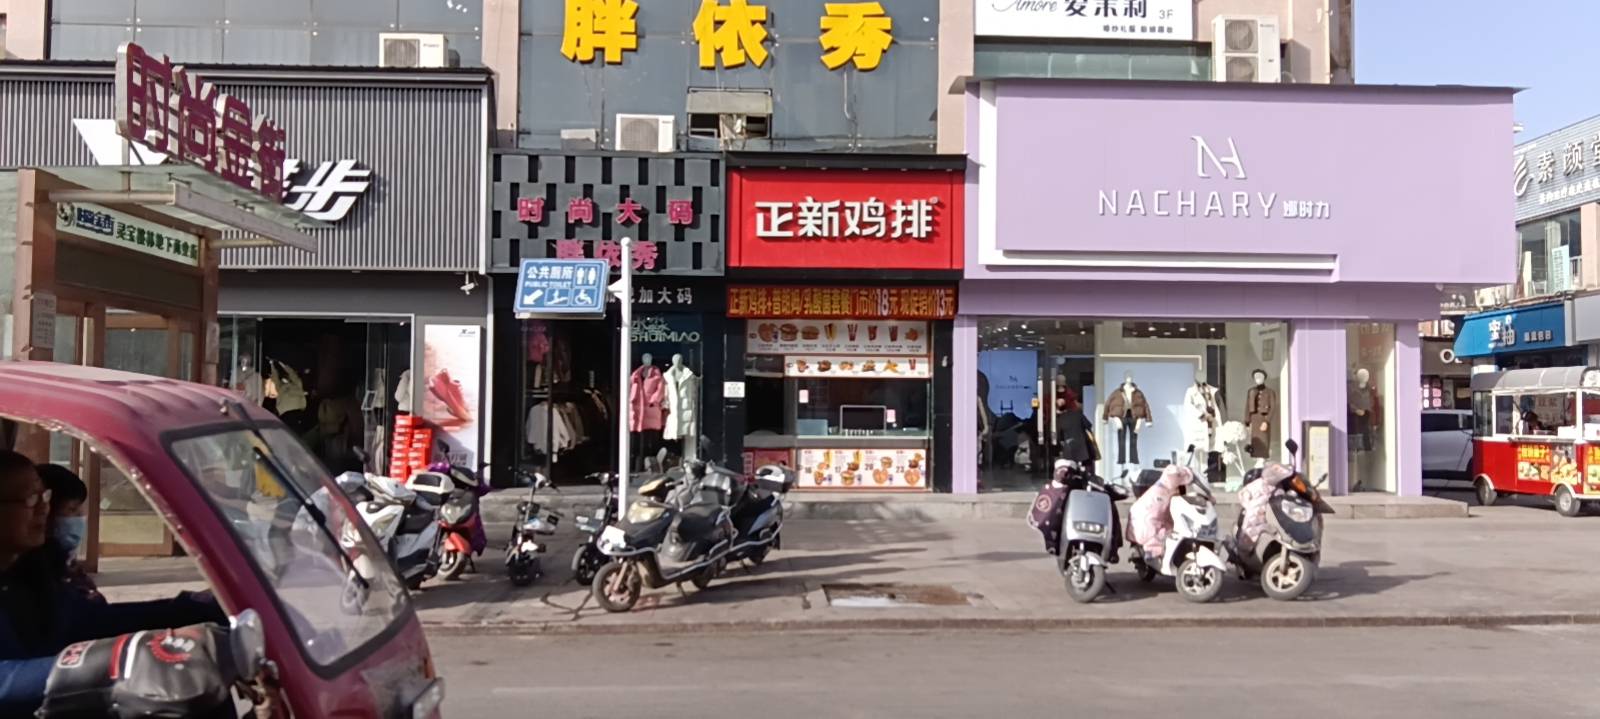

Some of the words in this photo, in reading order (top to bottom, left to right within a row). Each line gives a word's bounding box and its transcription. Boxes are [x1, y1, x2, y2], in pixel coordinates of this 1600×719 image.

[1159, 9, 1174, 20] 3F
[561, 0, 893, 71] 胖依秀
[116, 42, 286, 206] 时尚金街
[517, 197, 693, 225] 时尚大码
[754, 195, 934, 240] 正新鸡排
[1098, 189, 1277, 218] NACHARY
[527, 266, 573, 280] 公共厕所
